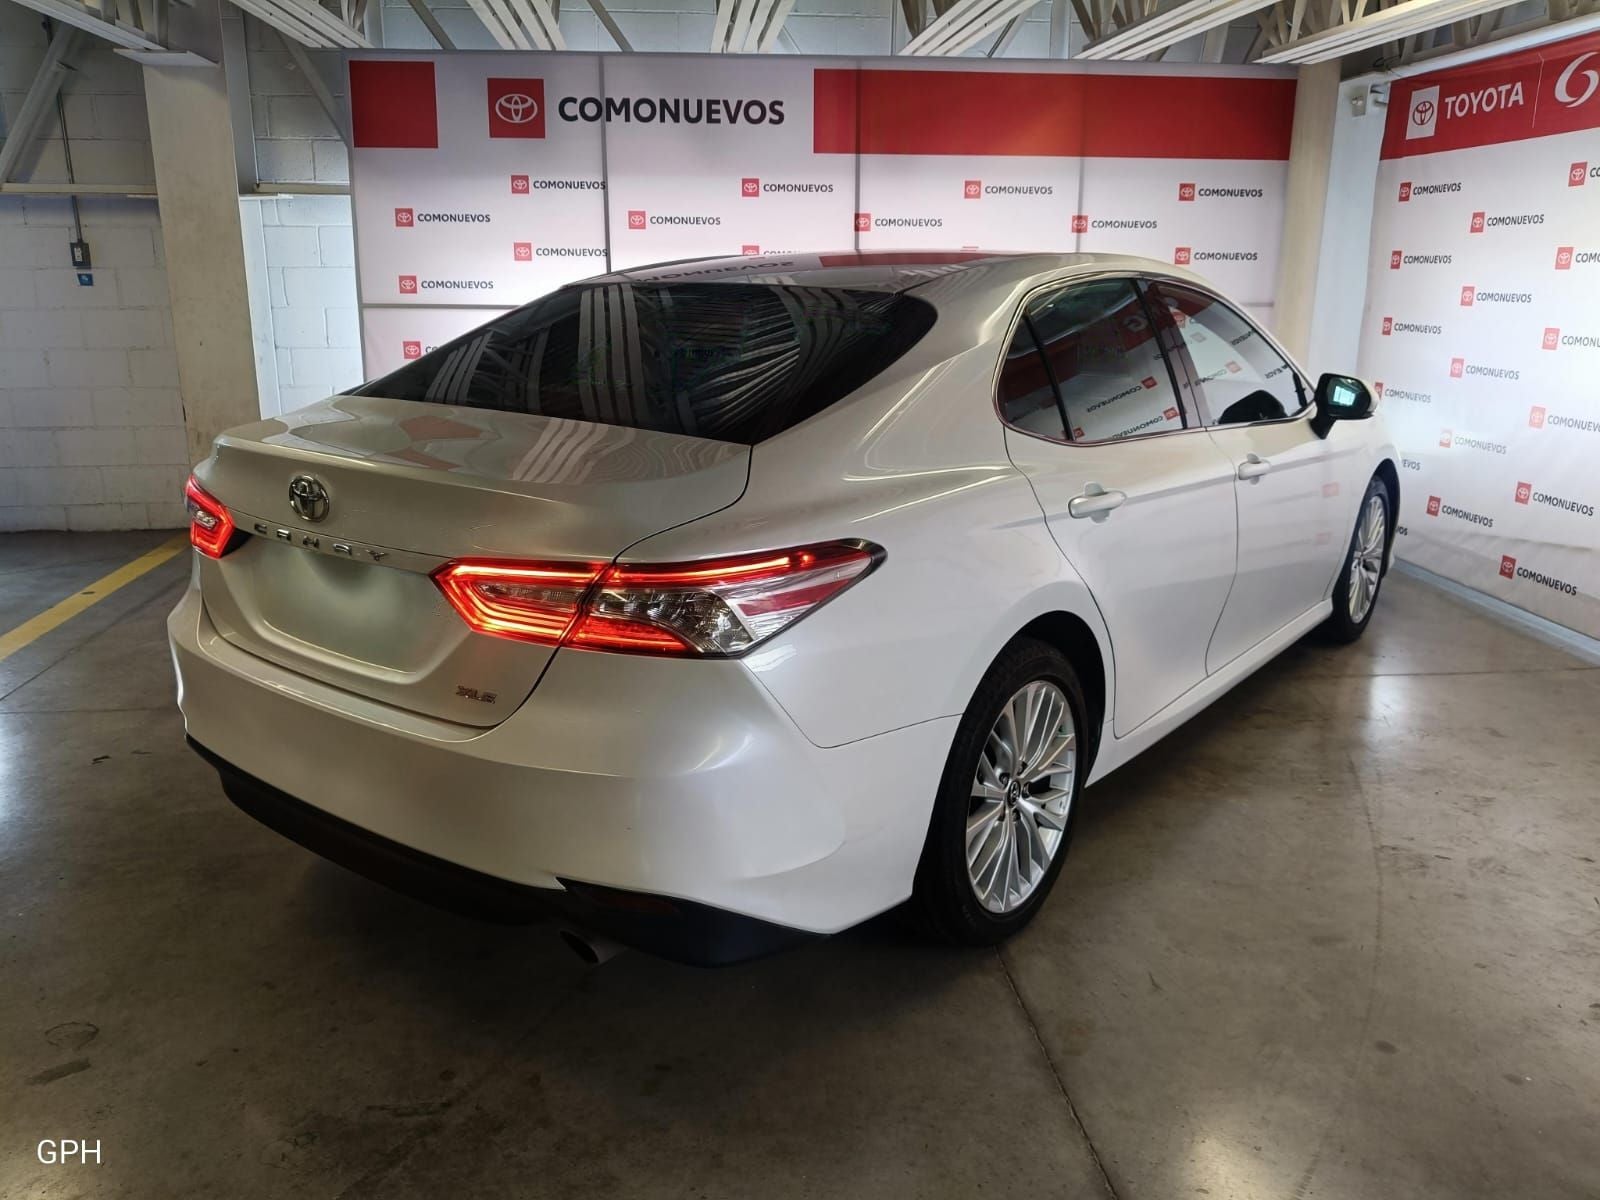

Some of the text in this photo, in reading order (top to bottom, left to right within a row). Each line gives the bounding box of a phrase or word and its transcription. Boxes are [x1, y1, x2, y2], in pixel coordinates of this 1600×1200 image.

[1444, 81, 1524, 119] TOYOTA
[558, 96, 785, 125] COMONUEVOS
[533, 180, 606, 190] COMONUEVOS
[763, 182, 834, 193] COMONUEVOS
[985, 184, 1053, 195] COMONUEVOS
[1412, 182, 1462, 195] COMONUEVOS
[1198, 187, 1263, 198] COMONUEVOS
[417, 213, 491, 223] COMONUEVOS
[649, 215, 721, 226] COMONUEVOS
[874, 217, 943, 227] COMONUEVOS
[1486, 213, 1545, 227] COMONUEVOS
[1091, 219, 1158, 229] COMONUEVOS
[535, 247, 608, 257] COMONUEVOS
[1193, 251, 1258, 261] COMONUEVOS
[1403, 254, 1452, 265] COMONUEVOS
[420, 279, 494, 289] COMONUEVOS
[1476, 292, 1532, 304] COMONUEVOS
[1393, 322, 1442, 335] COMONUEVOS
[1465, 364, 1520, 381] COMONUEVOS
[1384, 388, 1431, 404] COMONUEVOS
[1454, 436, 1507, 455] COMONUEVOS
[1532, 491, 1594, 517] COMONUEVOS
[1441, 503, 1493, 528] COMONUEVOS
[1516, 566, 1577, 597] COMONUEVOS
